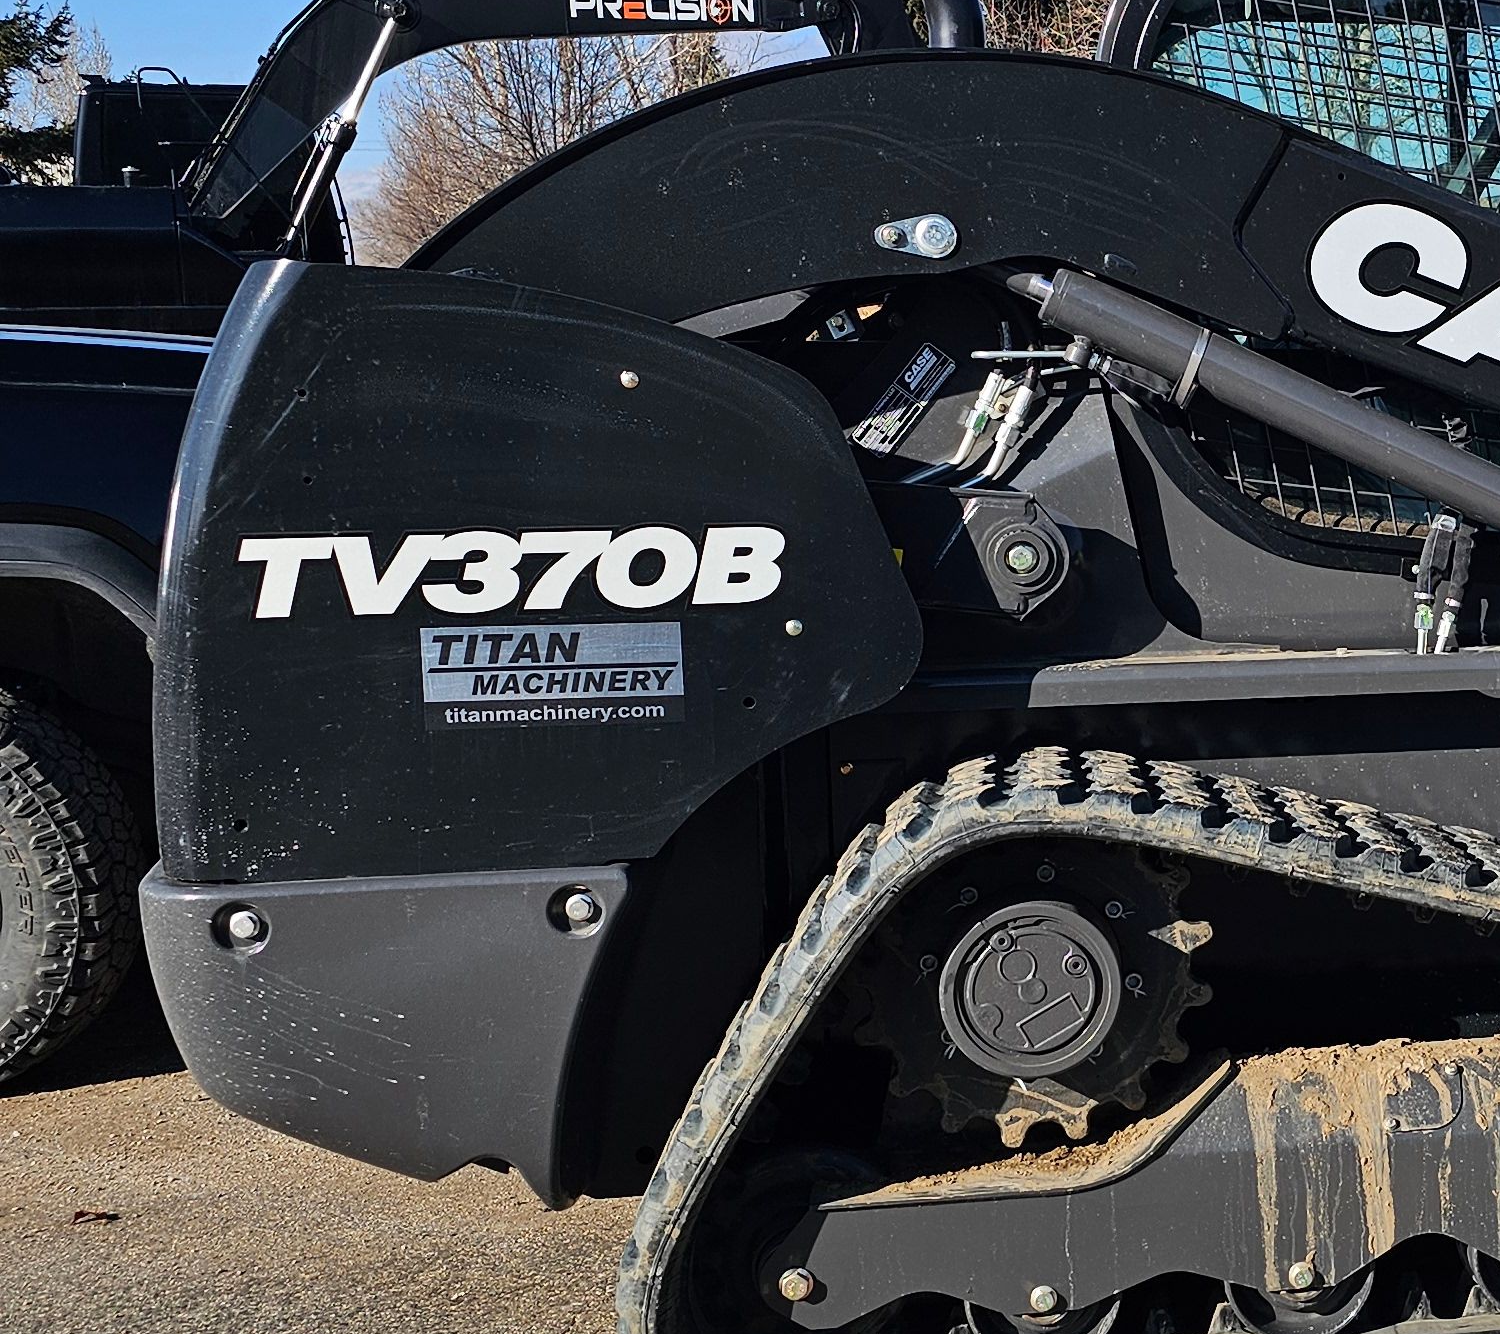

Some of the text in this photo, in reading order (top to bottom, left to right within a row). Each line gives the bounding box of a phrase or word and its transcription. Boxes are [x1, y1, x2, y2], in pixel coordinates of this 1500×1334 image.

[904, 346, 934, 384] CASE
[237, 526, 786, 619] TV370B
[431, 632, 581, 666] TITAN
[471, 669, 674, 696] MACHINERY
[444, 702, 666, 724] titanmachinery.com
